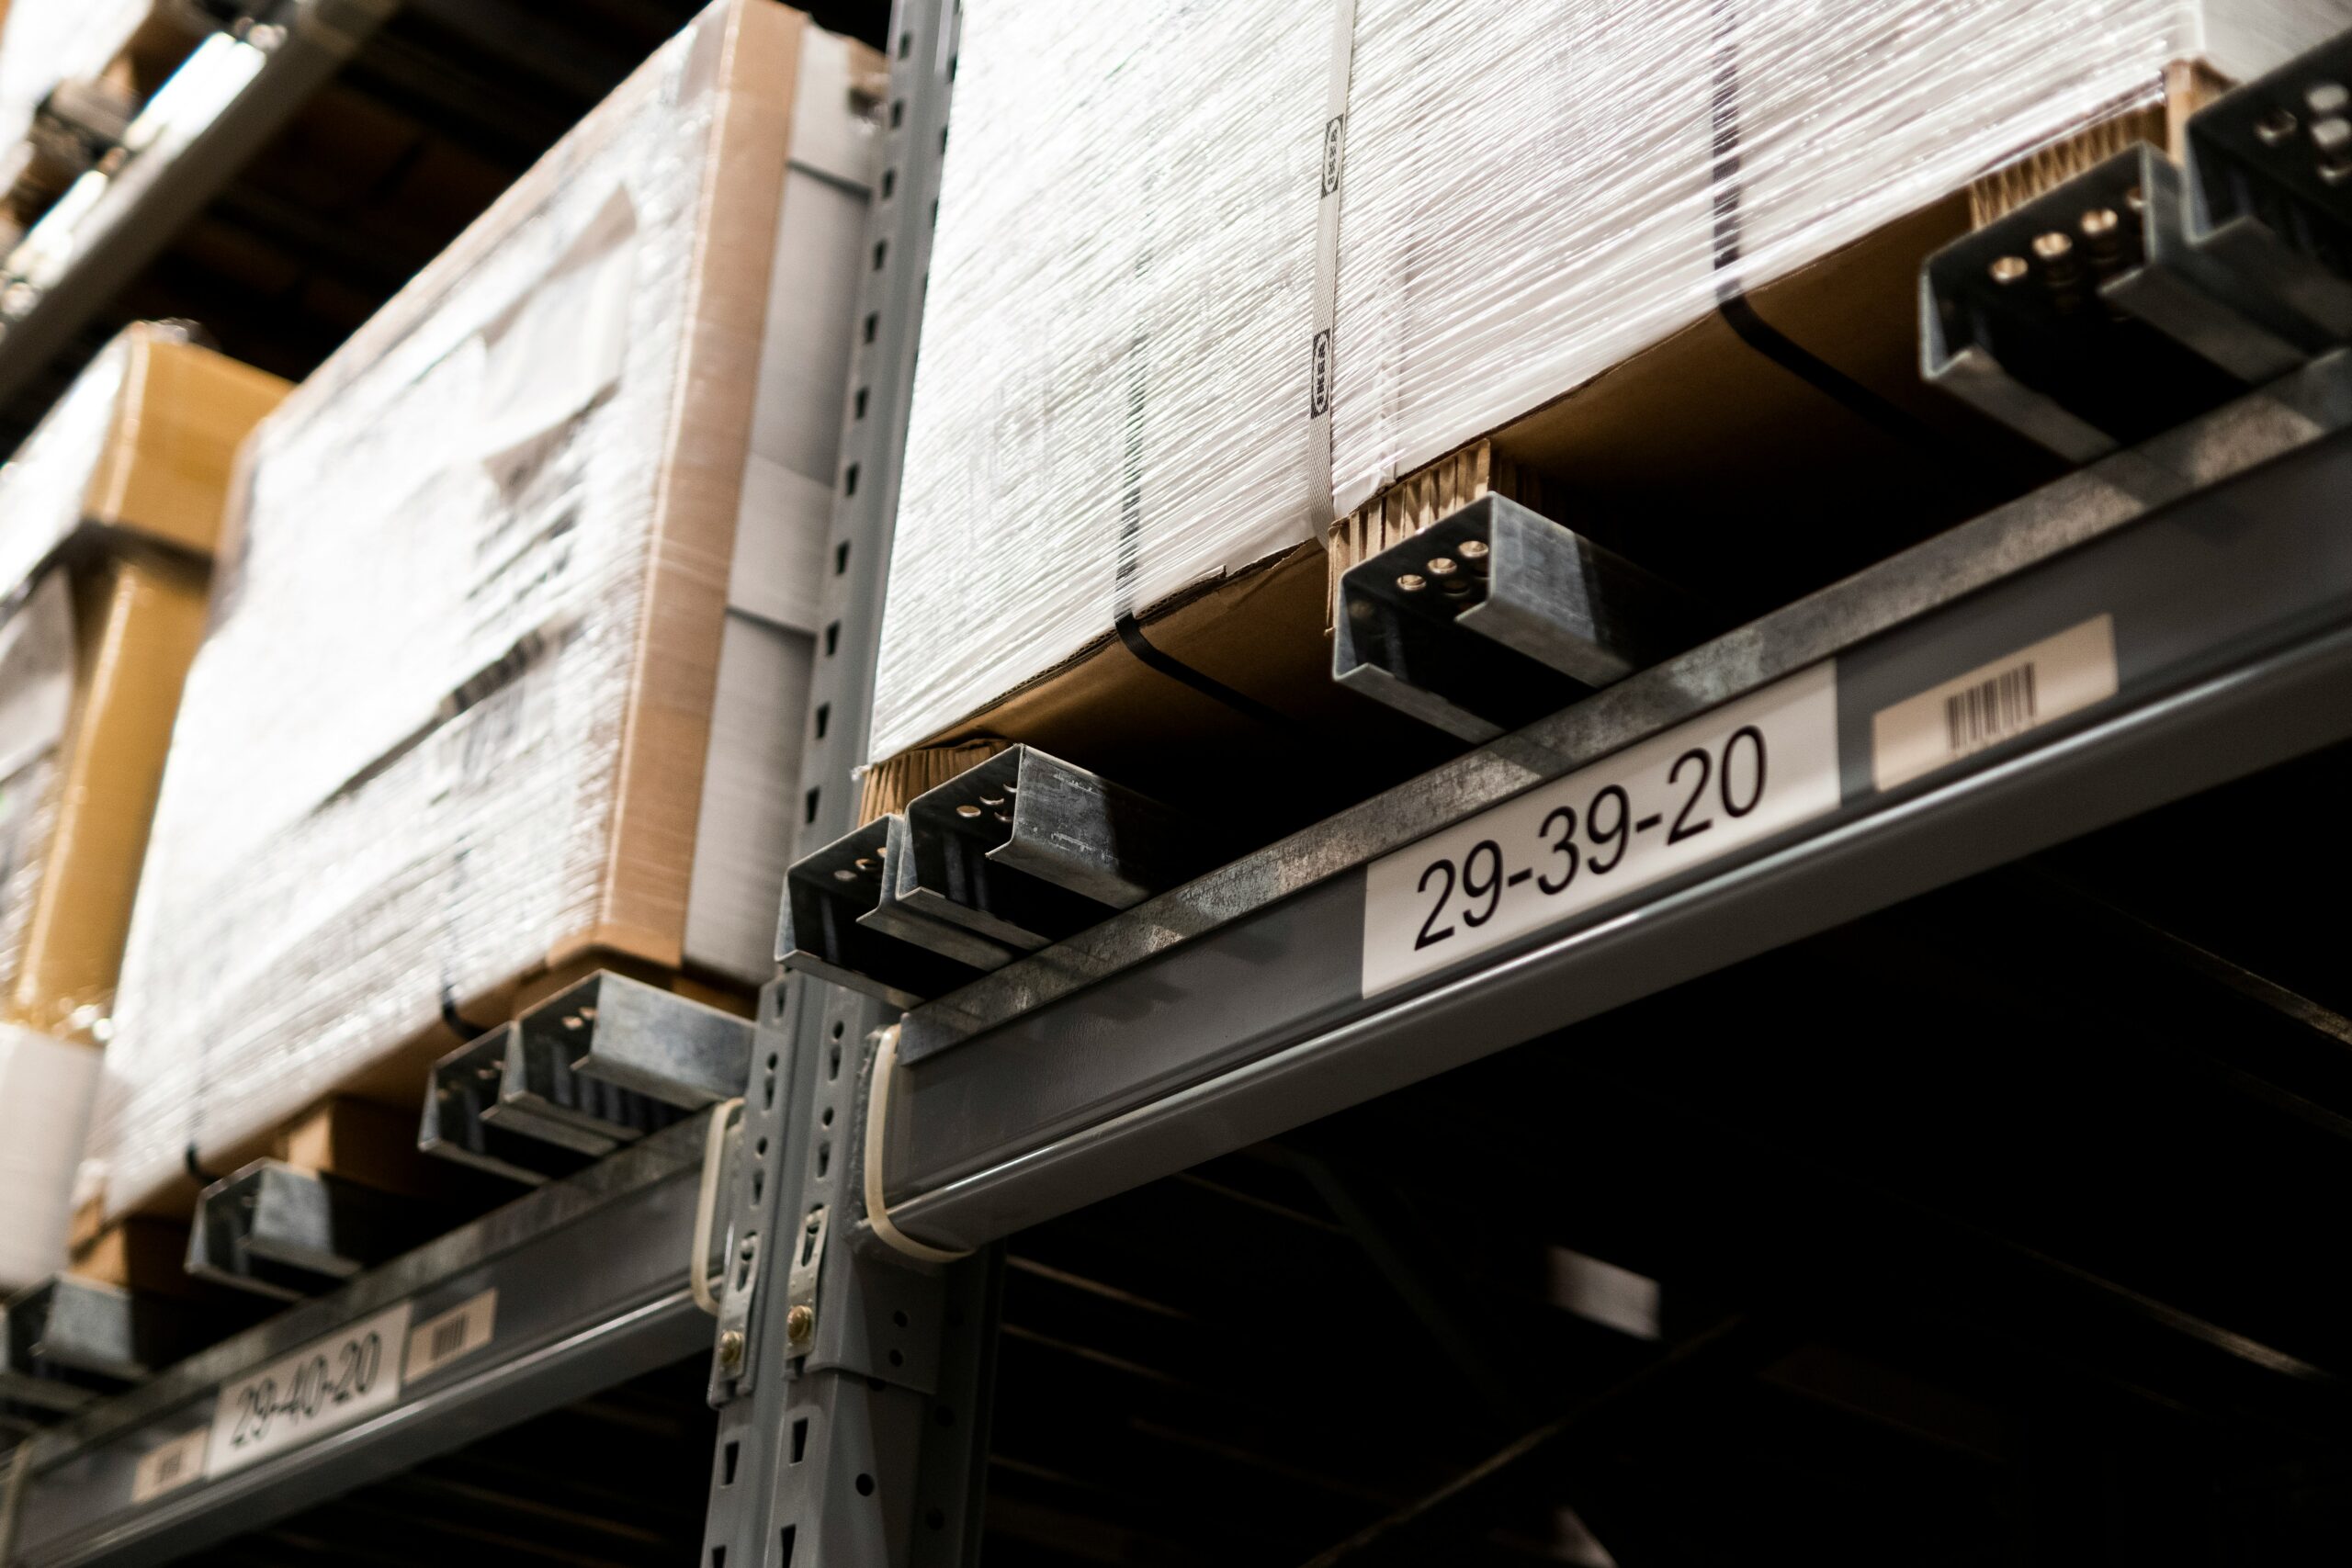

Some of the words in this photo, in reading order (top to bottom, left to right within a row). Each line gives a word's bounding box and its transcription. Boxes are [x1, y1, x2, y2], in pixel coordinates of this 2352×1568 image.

[1316, 340, 1327, 406] IKEA
[1413, 725, 1767, 952] 29-39-20
[231, 1331, 382, 1447] 29-40-20
